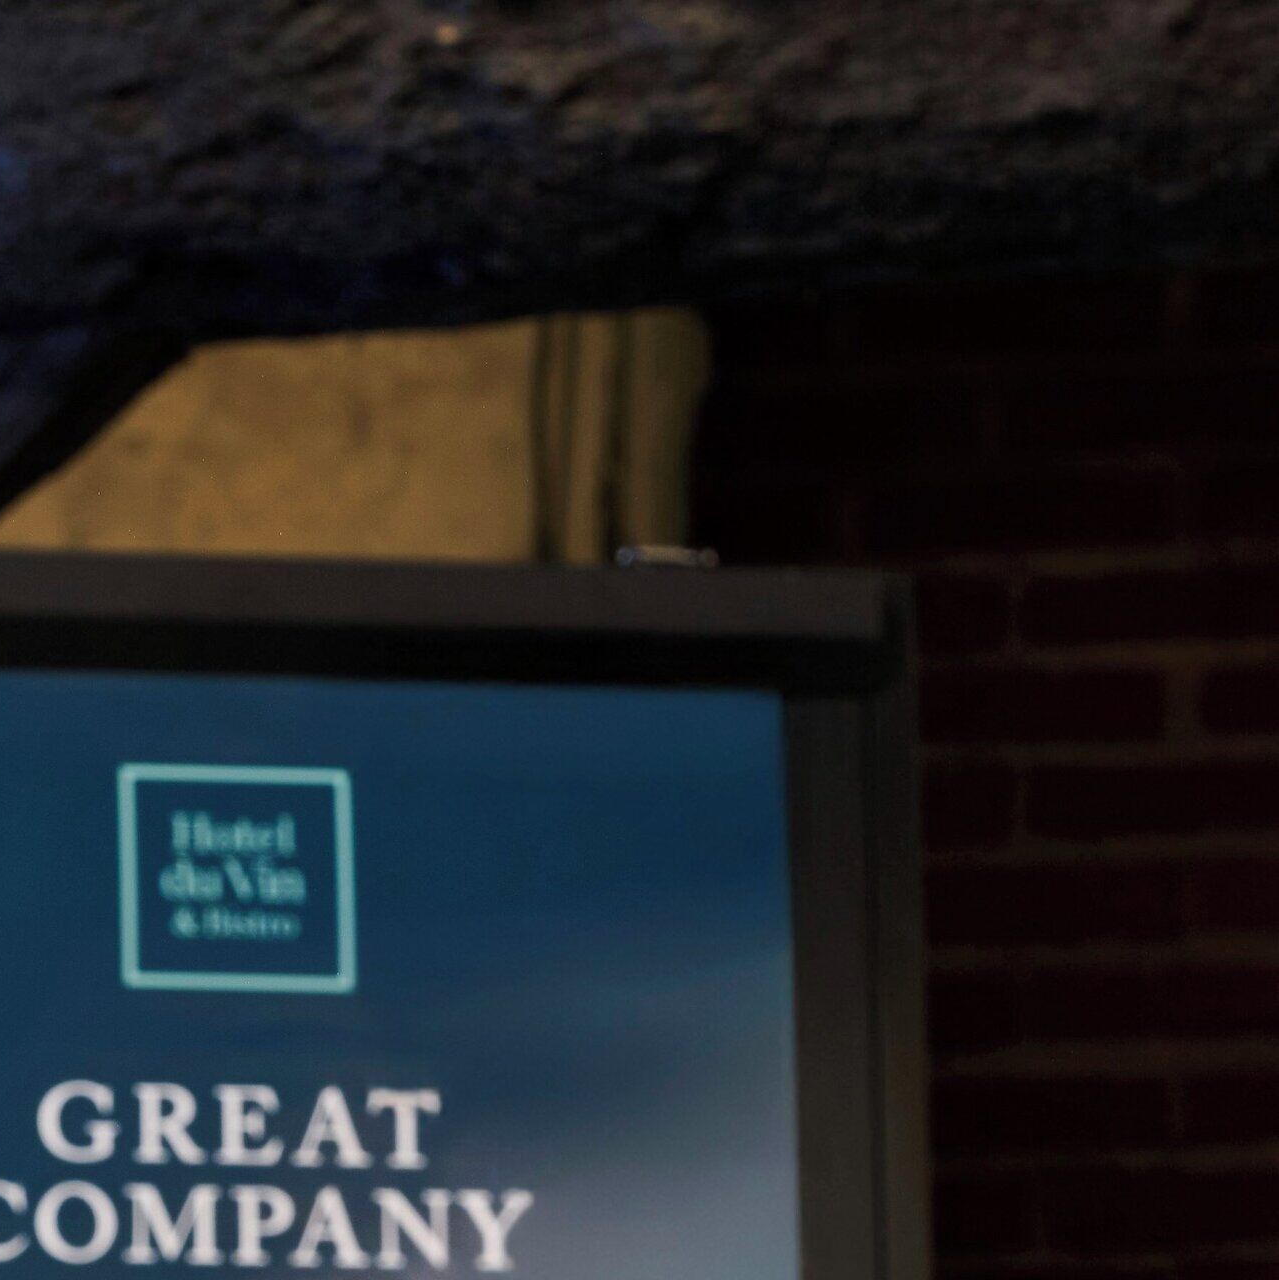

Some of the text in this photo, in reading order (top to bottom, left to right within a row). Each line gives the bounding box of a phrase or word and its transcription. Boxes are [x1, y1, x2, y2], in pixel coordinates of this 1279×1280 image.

[171, 808, 297, 858] Hotel
[158, 853, 309, 905] du Vin
[35, 1078, 443, 1171] GREAT
